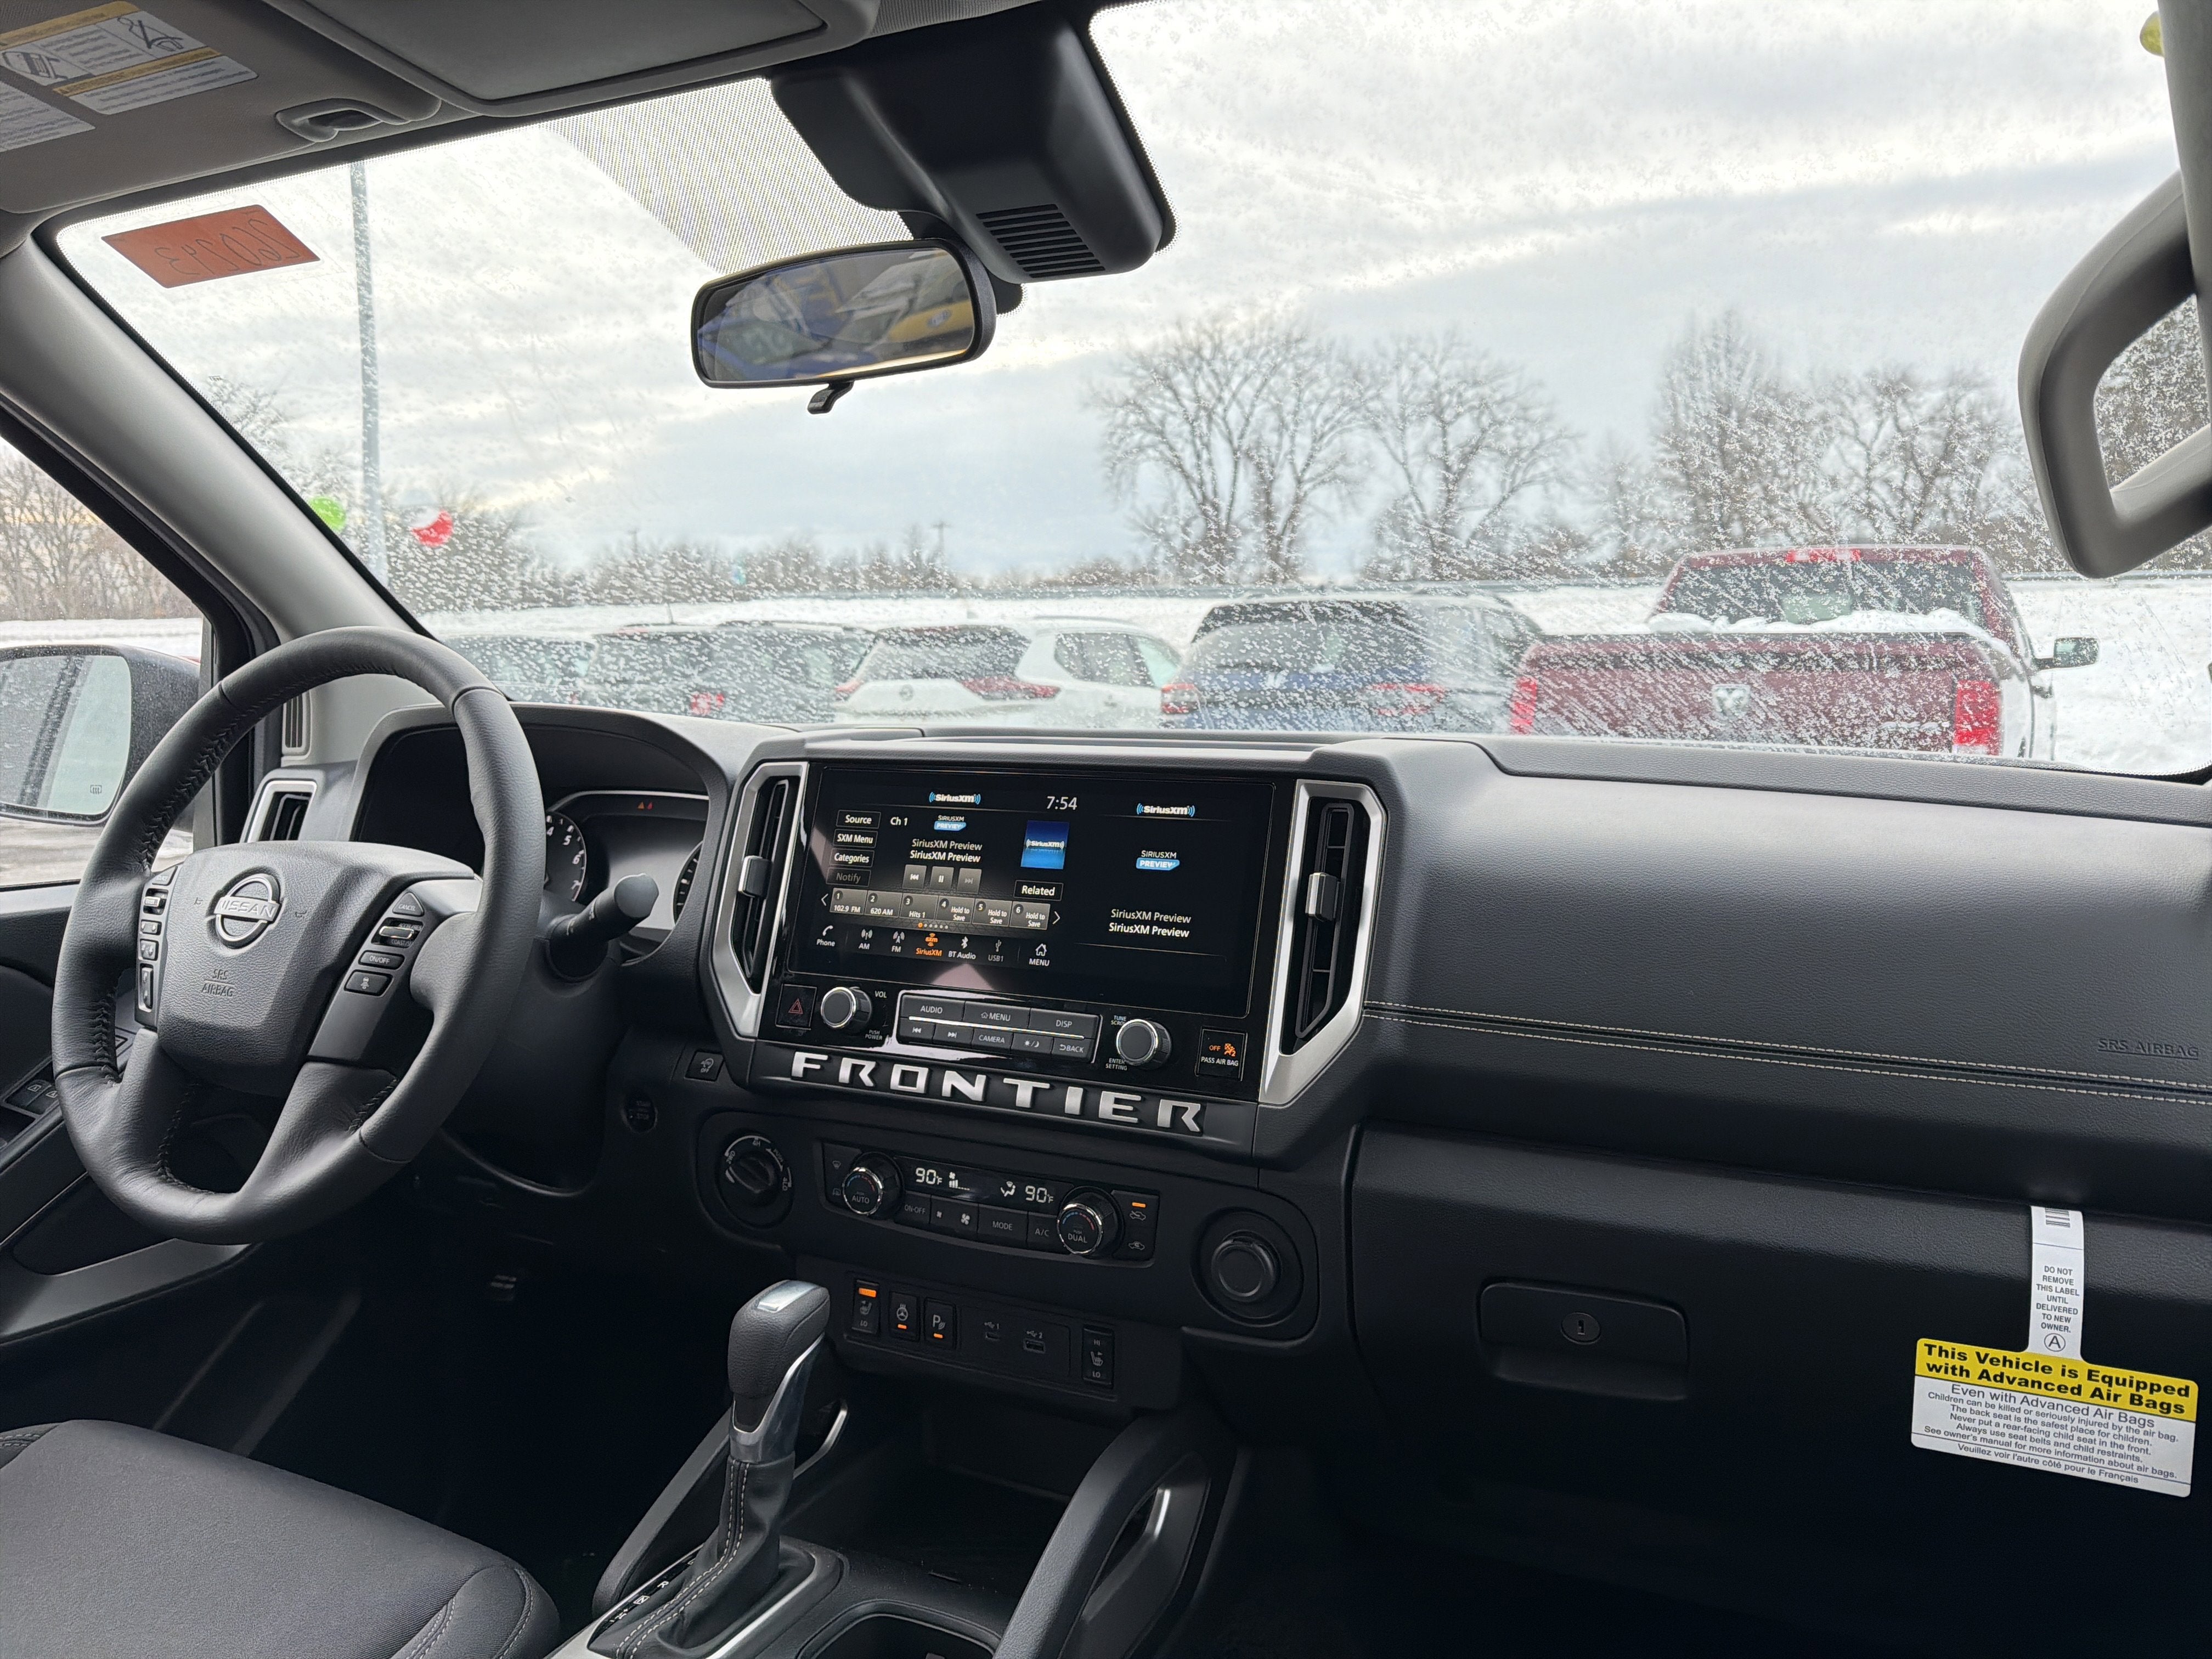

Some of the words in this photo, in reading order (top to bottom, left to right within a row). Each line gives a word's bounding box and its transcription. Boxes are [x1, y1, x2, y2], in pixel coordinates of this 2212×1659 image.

[1046, 795, 1077, 810] 7:54
[845, 814, 872, 824] Source
[890, 816, 901, 826] Ch
[904, 817, 908, 826] 1
[837, 833, 853, 843] SXM
[854, 834, 873, 844] Menu
[912, 838, 948, 850] SiriusXM
[950, 840, 983, 851] Preview
[834, 853, 870, 864] Categories
[910, 850, 946, 861] SiriusXM
[947, 852, 981, 863] Preview
[1141, 850, 1177, 859] SIRIUSXM
[1139, 860, 1175, 868] PREVIEW
[836, 872, 861, 884] Notify
[1022, 885, 1056, 896] Related
[217, 897, 275, 919] NISSAN
[1110, 909, 1152, 921] SiriusXM
[1154, 912, 1192, 923] Preview
[1109, 922, 1150, 935] SiriusXM
[1152, 926, 1190, 938] Preview
[816, 939, 836, 947] Phone
[915, 947, 943, 956] SiriusXM
[369, 955, 390, 964] ON/OFF
[1029, 958, 1050, 967] MENU
[212, 968, 228, 980] SRS
[201, 984, 234, 997] AIRBAG
[874, 990, 887, 998] VOL
[920, 1005, 943, 1014] AUDIO
[989, 1012, 1011, 1022] MENU
[1056, 1019, 1073, 1028] DISP
[979, 1035, 1005, 1044] CAMERA
[1066, 1045, 1084, 1053] BACK
[2098, 1038, 2129, 1051] SRS
[2134, 1041, 2199, 1058] AIRBAG
[791, 1051, 1201, 1133] FRONTIER
[851, 1195, 870, 1204] AUTO
[992, 1221, 1013, 1231] MODE
[1035, 1228, 1049, 1237] A/C
[1068, 1233, 1088, 1243] DUAL
[2057, 1267, 2073, 1276] NOT
[2042, 1274, 2074, 1285] REMOVE
[2036, 1283, 2053, 1293] THIS
[2055, 1286, 2080, 1296] LABEL
[2046, 1295, 2068, 1304] UNTIL
[2036, 1302, 2078, 1315] DELIVERED
[2053, 1314, 2071, 1323] NEW
[2041, 1322, 2071, 1333] OWNER.
[2048, 1335, 2061, 1349] A
[1923, 1343, 1968, 1361] This
[1975, 1351, 2053, 1374] Vehicle
[2061, 1364, 2079, 1379] is
[2086, 1369, 2190, 1398] Equipped
[1926, 1362, 1970, 1379] with
[1977, 1369, 2082, 1397] Advanced
[2089, 1387, 2122, 1403] Air
[2129, 1393, 2185, 1415] Bags
[1951, 1383, 1985, 1399] Even
[1989, 1391, 2016, 1404] with
[2019, 1395, 2090, 1416] Advanced
[2093, 1408, 2114, 1420] Air
[2118, 1412, 2155, 1429] Bags
[1928, 1391, 1964, 1404] Children
[1984, 1401, 1996, 1409] be
[1999, 1403, 2021, 1414] killed
[2035, 1410, 2075, 1425] seriously
[2078, 1416, 2109, 1429] injured
[2112, 1420, 2124, 1433] by
[2125, 1425, 2140, 1435] the
[2143, 1429, 2155, 1438] air
[2158, 1431, 2179, 1443] bag.
[1950, 1404, 1967, 1413] The
[1970, 1406, 1990, 1417] back
[1993, 1411, 2012, 1421] seat
[2014, 1414, 2022, 1423] is
[2024, 1416, 2038, 1425] the
[2041, 1419, 2068, 1431] safest
[2070, 1425, 2095, 1436] place
[2098, 1429, 2111, 1438] for
[2113, 1432, 2152, 1447] children.
[1950, 1413, 1976, 1424] Never
[1978, 1418, 1992, 1427] put
[2002, 1421, 2050, 1438] rear-facing
[2053, 1432, 2074, 1443] child
[2076, 1436, 2096, 1446] seat
[2099, 1438, 2107, 1447] in
[2110, 1441, 2125, 1450] the
[2128, 1444, 2151, 1455] front.
[1956, 1423, 1988, 1435] Always
[1990, 1430, 2006, 1438] use
[2008, 1432, 2027, 1442] seat
[2029, 1434, 2051, 1446] belts
[2053, 1440, 2070, 1449] and
[2073, 1443, 2095, 1454] child
[2097, 1448, 2143, 1463] restraints.
[1924, 1425, 1942, 1435] See
[1944, 1431, 1977, 1441] owner's
[1980, 1436, 2012, 1448] manual
[2015, 1441, 2027, 1451] for
[2029, 1445, 2052, 1454] more
[2054, 1449, 2105, 1465] information
[2107, 1460, 2134, 1471] about
[2136, 1463, 2149, 1472] air
[2151, 1465, 2177, 1479] bags.
[1957, 1443, 1991, 1456] Veuillez
[1994, 1450, 2011, 1459] voir
[2012, 1454, 2040, 1465] l'autre
[2042, 1457, 2062, 1469] côté
[2064, 1464, 2086, 1473] pour
[2087, 1467, 2096, 1475] le
[2098, 1469, 2138, 1484] Français
